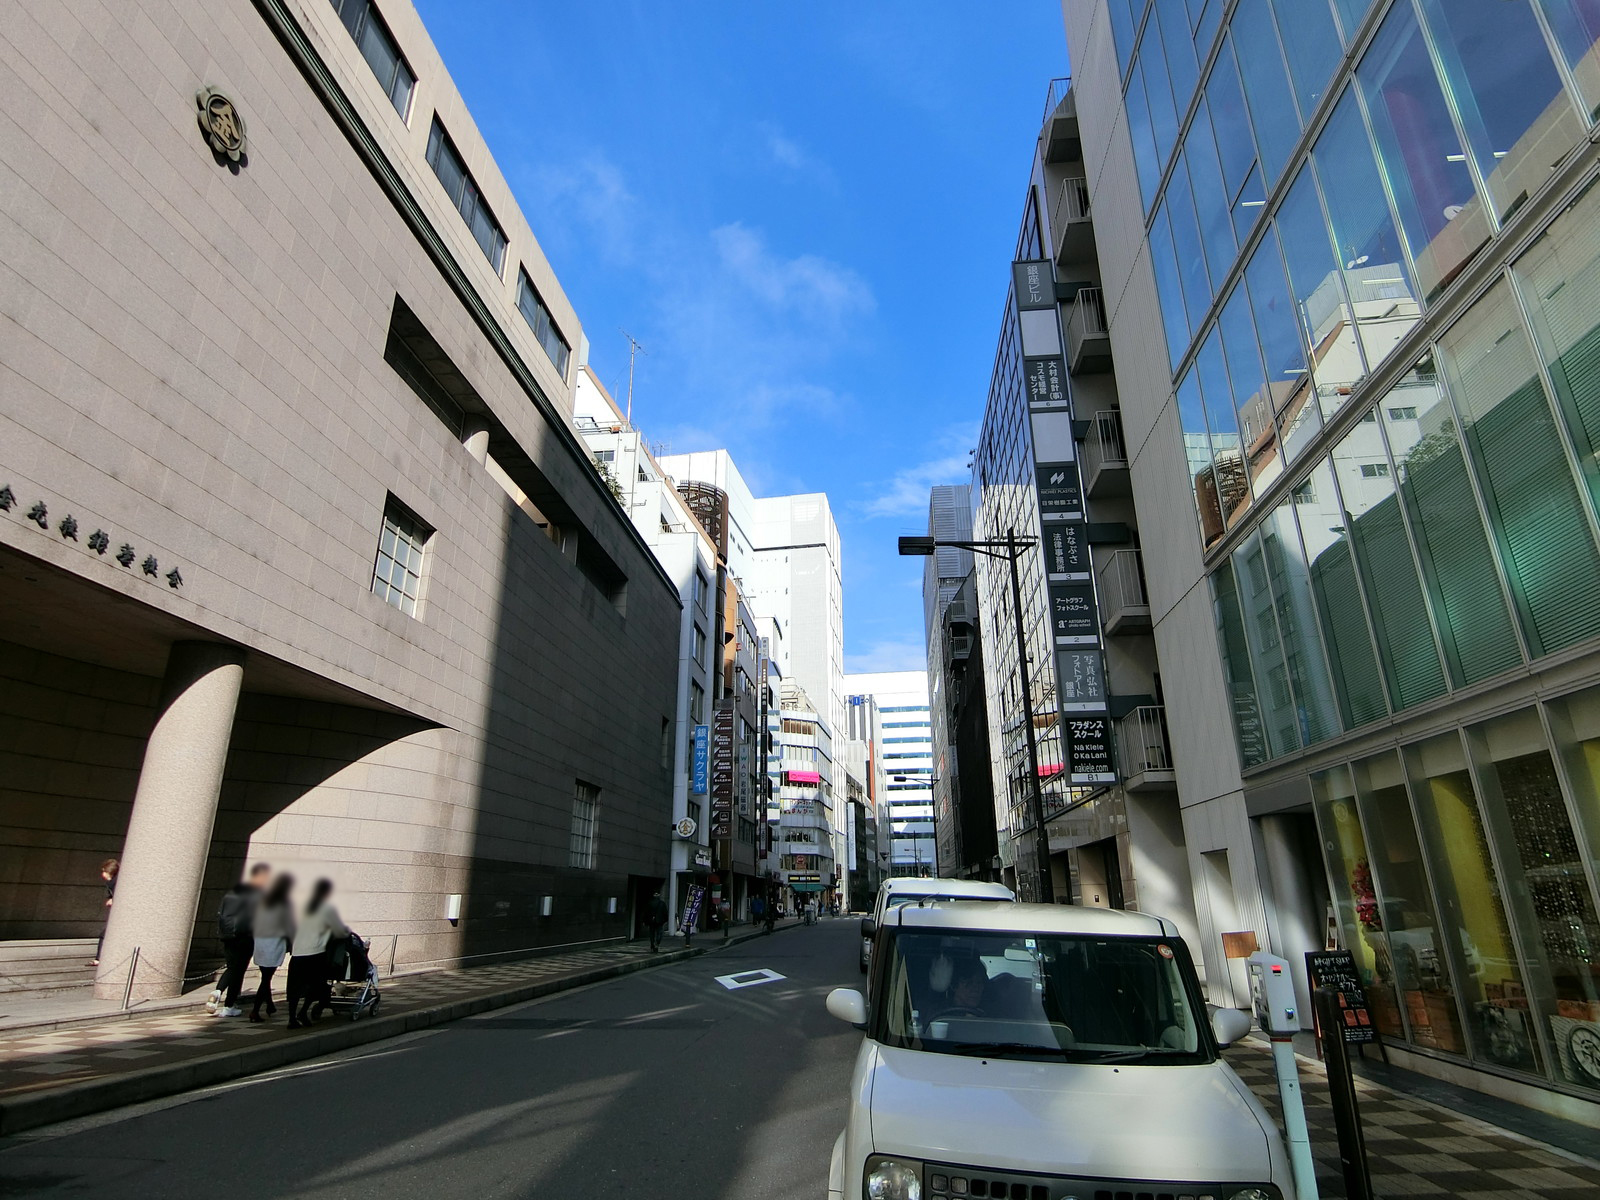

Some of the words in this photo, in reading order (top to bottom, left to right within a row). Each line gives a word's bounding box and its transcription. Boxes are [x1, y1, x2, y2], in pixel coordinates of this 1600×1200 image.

[1026, 265, 1042, 303] 銀座ビル
[1029, 375, 1038, 401] センター
[1052, 533, 1065, 573] 法律事務所
[1065, 527, 1078, 564] はなぶさ
[1056, 604, 1089, 612] フォトスクール
[1071, 655, 1084, 697] フォトアート
[1083, 655, 1099, 697] 写真弘社
[1065, 681, 1075, 698] 銀座
[1069, 720, 1104, 730] フラダンス
[1073, 730, 1102, 739] スクール
[695, 728, 707, 791] 銀座サクラヤ
[1091, 751, 1107, 759] Lani
[1074, 763, 1109, 773] nakiele.com
[1087, 773, 1099, 781] B1
